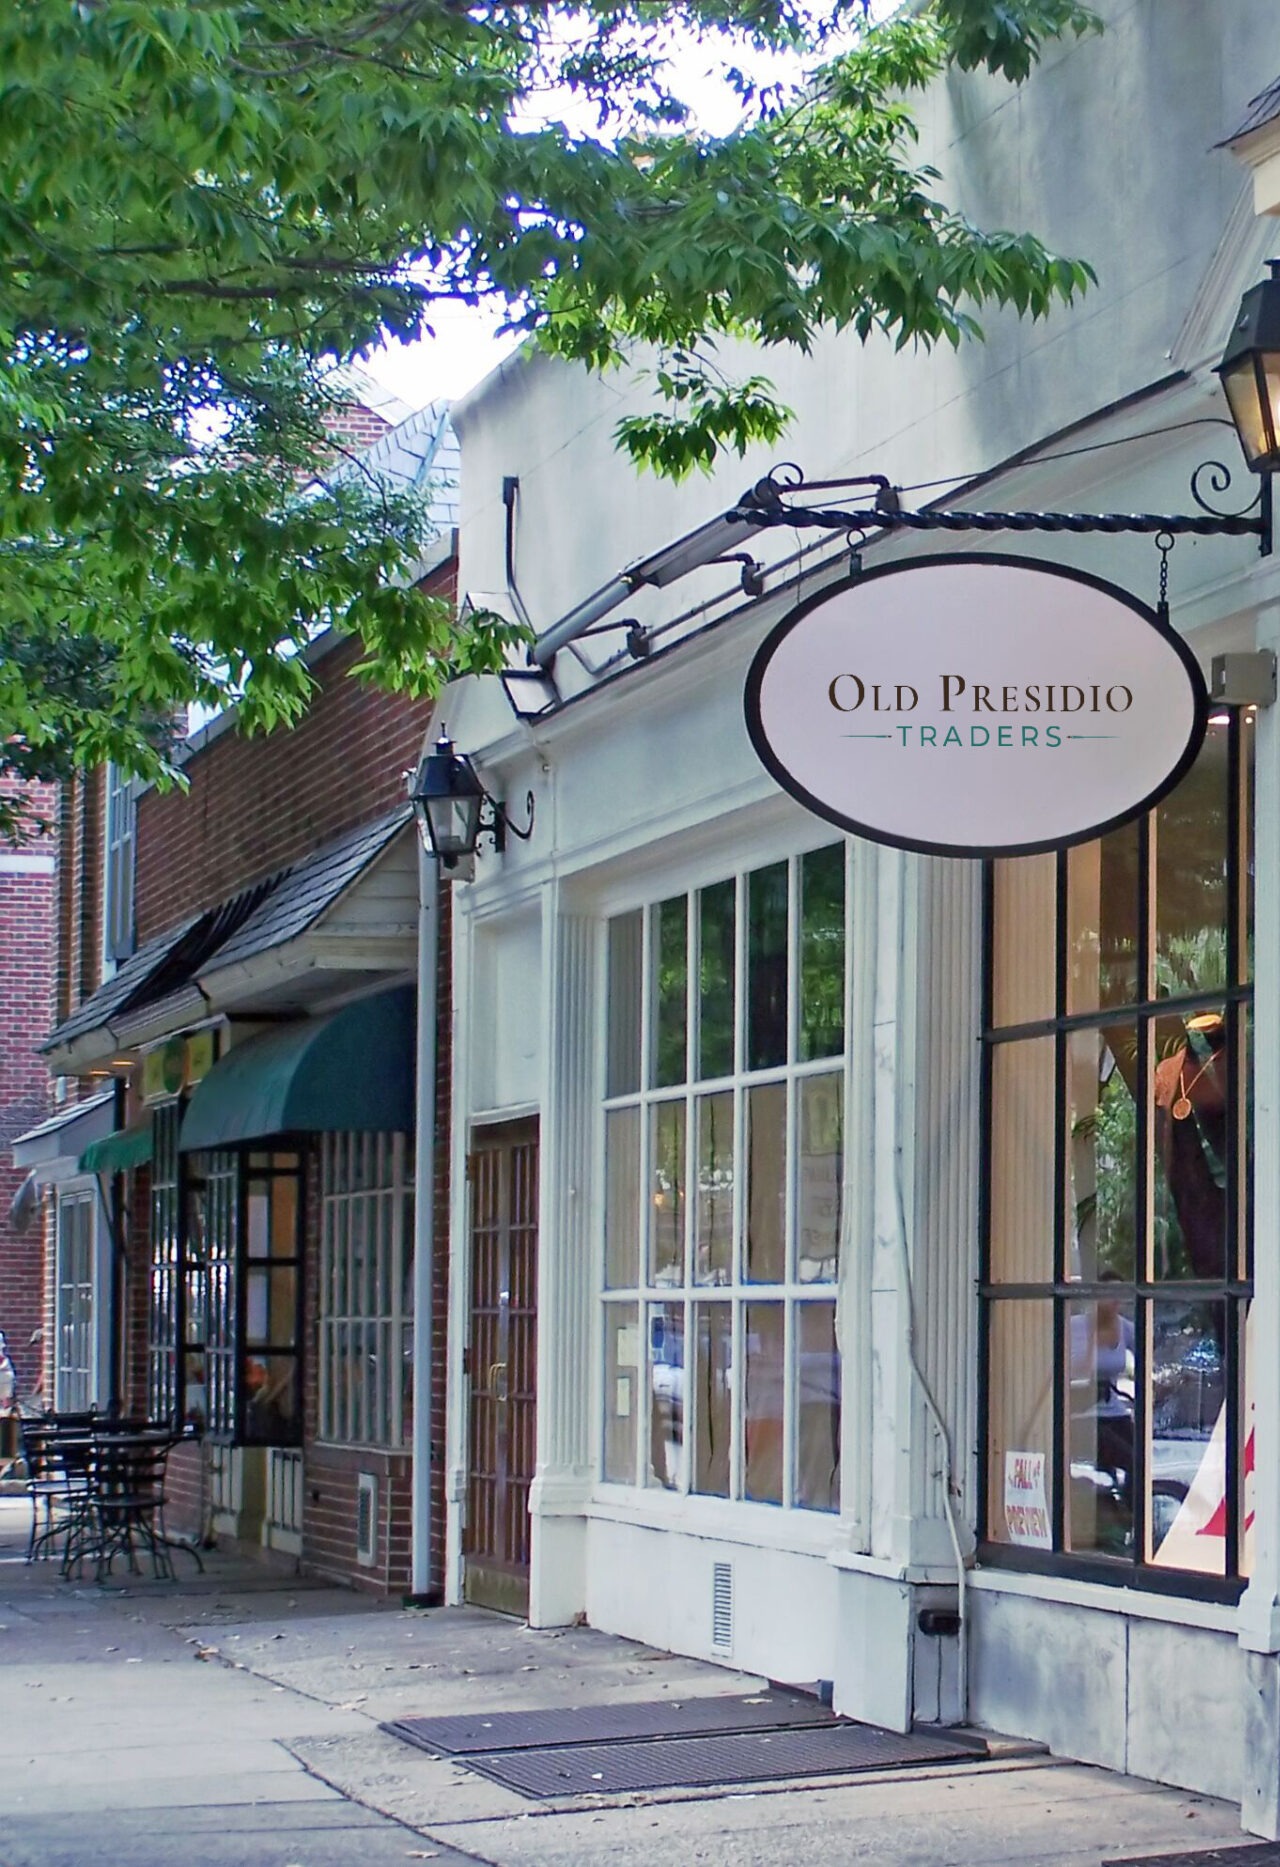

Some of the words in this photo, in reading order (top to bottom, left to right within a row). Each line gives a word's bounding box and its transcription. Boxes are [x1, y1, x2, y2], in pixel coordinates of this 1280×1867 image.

[827, 673, 919, 713] OLD
[938, 673, 1134, 713] PRESIDIO
[895, 724, 1063, 748] TRADERS
